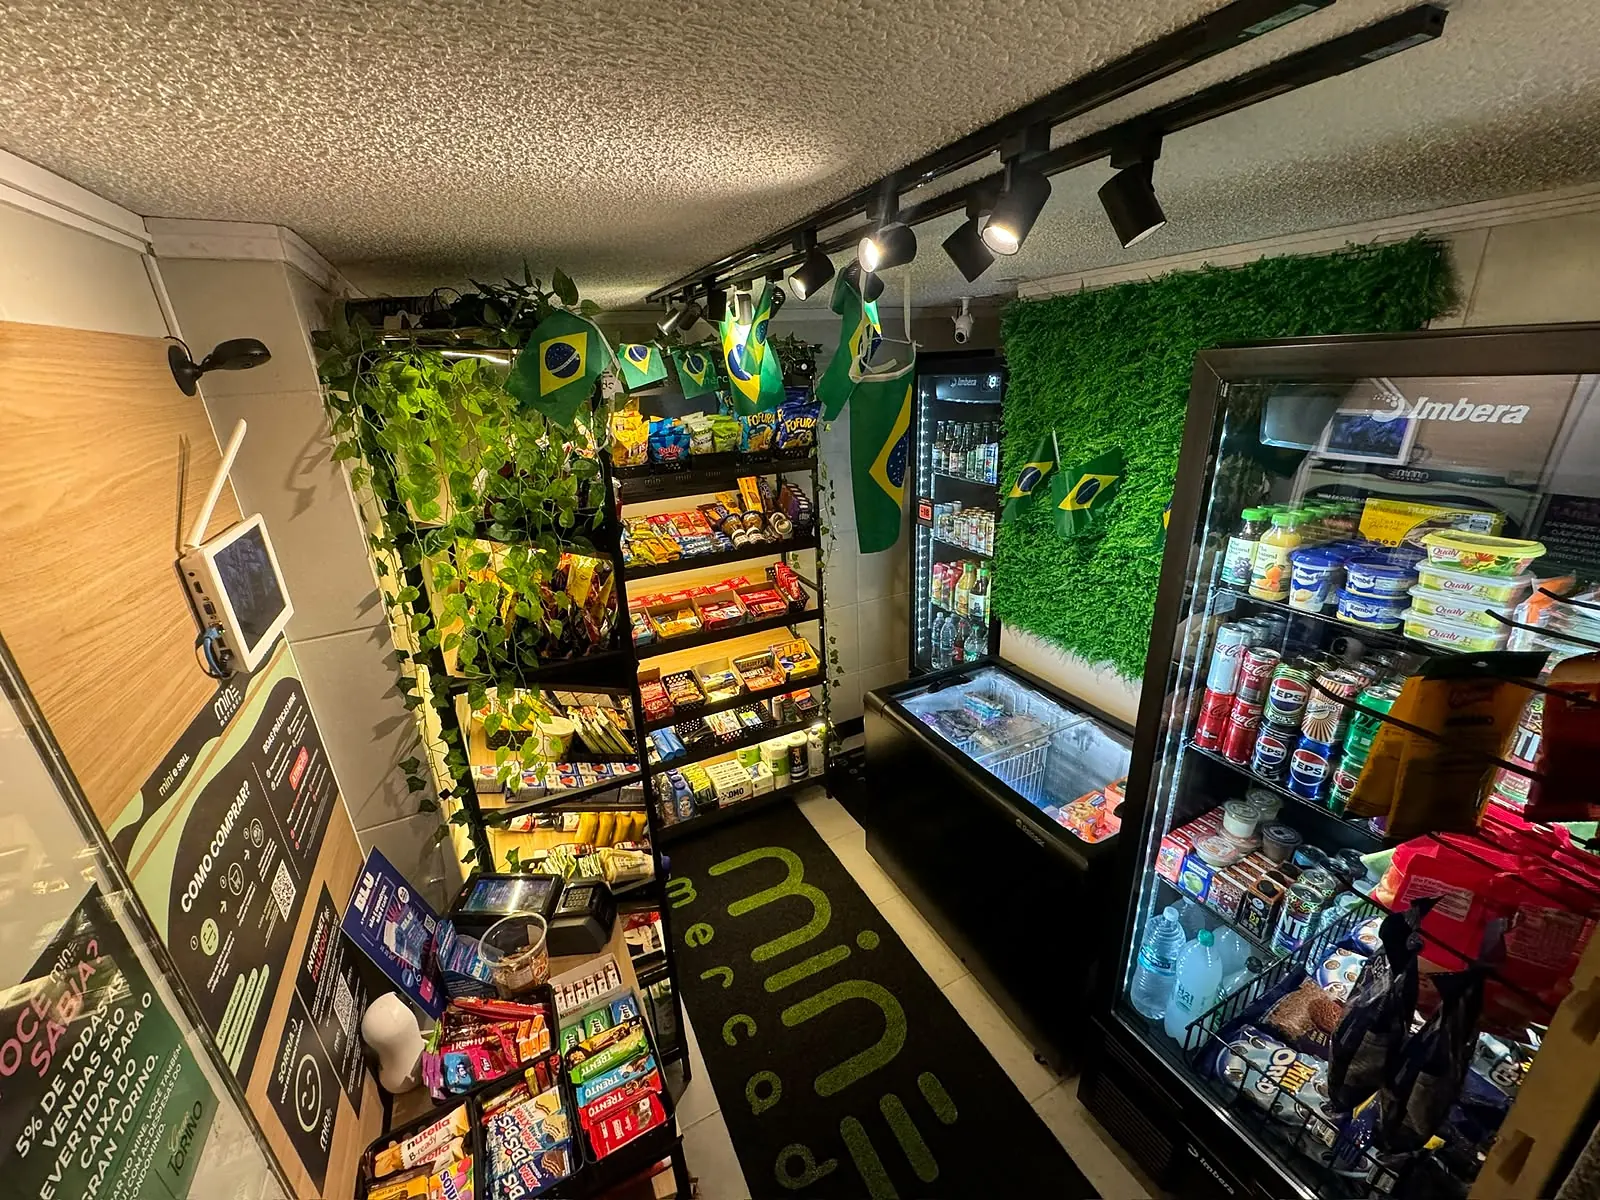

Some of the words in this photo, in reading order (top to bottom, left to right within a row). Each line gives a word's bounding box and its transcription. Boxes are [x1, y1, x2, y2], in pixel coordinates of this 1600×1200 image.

[785, 417, 818, 433] FOFURA
[1407, 397, 1530, 424] Imbera
[1433, 547, 1460, 558] Qualy
[1443, 580, 1476, 592] Qualy
[1435, 605, 1467, 617] Qualy
[1428, 628, 1461, 641] Qualy
[1271, 685, 1307, 703] PEPSI
[1257, 741, 1285, 757] PEPSI
[1292, 757, 1327, 777] PEPSI
[728, 787, 745, 799] OMO
[181, 854, 213, 913] COMO
[210, 780, 251, 858] COMPRAR?
[353, 871, 375, 913] BLU
[306, 911, 325, 974] INTERNET
[30, 939, 102, 1078] SABIA?
[111, 1010, 145, 1066] PARA
[142, 992, 152, 1008] O
[15, 1115, 43, 1158] 5%
[40, 1074, 66, 1115] DE
[62, 1001, 108, 1074] TODAS
[107, 970, 125, 1004] AS
[277, 1031, 295, 1085] SORRIA
[42, 1050, 102, 1149] VENDAS
[99, 1008, 125, 1051] SÃO
[114, 1054, 160, 1136] TORINO.
[585, 1073, 620, 1098] TRENTO
[80, 1096, 120, 1169] CAIXA
[117, 1058, 136, 1095] DO
[588, 1091, 624, 1118] TRENTO
[127, 1156, 143, 1188] COM
[141, 1139, 150, 1157] AS
[148, 1081, 176, 1139] DESPESAS
[173, 1062, 182, 1082] DO
[167, 1100, 203, 1177] TORINO
[406, 1117, 451, 1151] nutella
[110, 1179, 124, 1200] AR
[121, 1157, 133, 1180] NO
[131, 1123, 150, 1157] MINE,
[408, 1133, 438, 1162] B-ready
[502, 1137, 529, 1165] BIS
[502, 1173, 525, 1200] BIS
[518, 1163, 541, 1193] XTRA
[1199, 1157, 1235, 1195] Imbera
